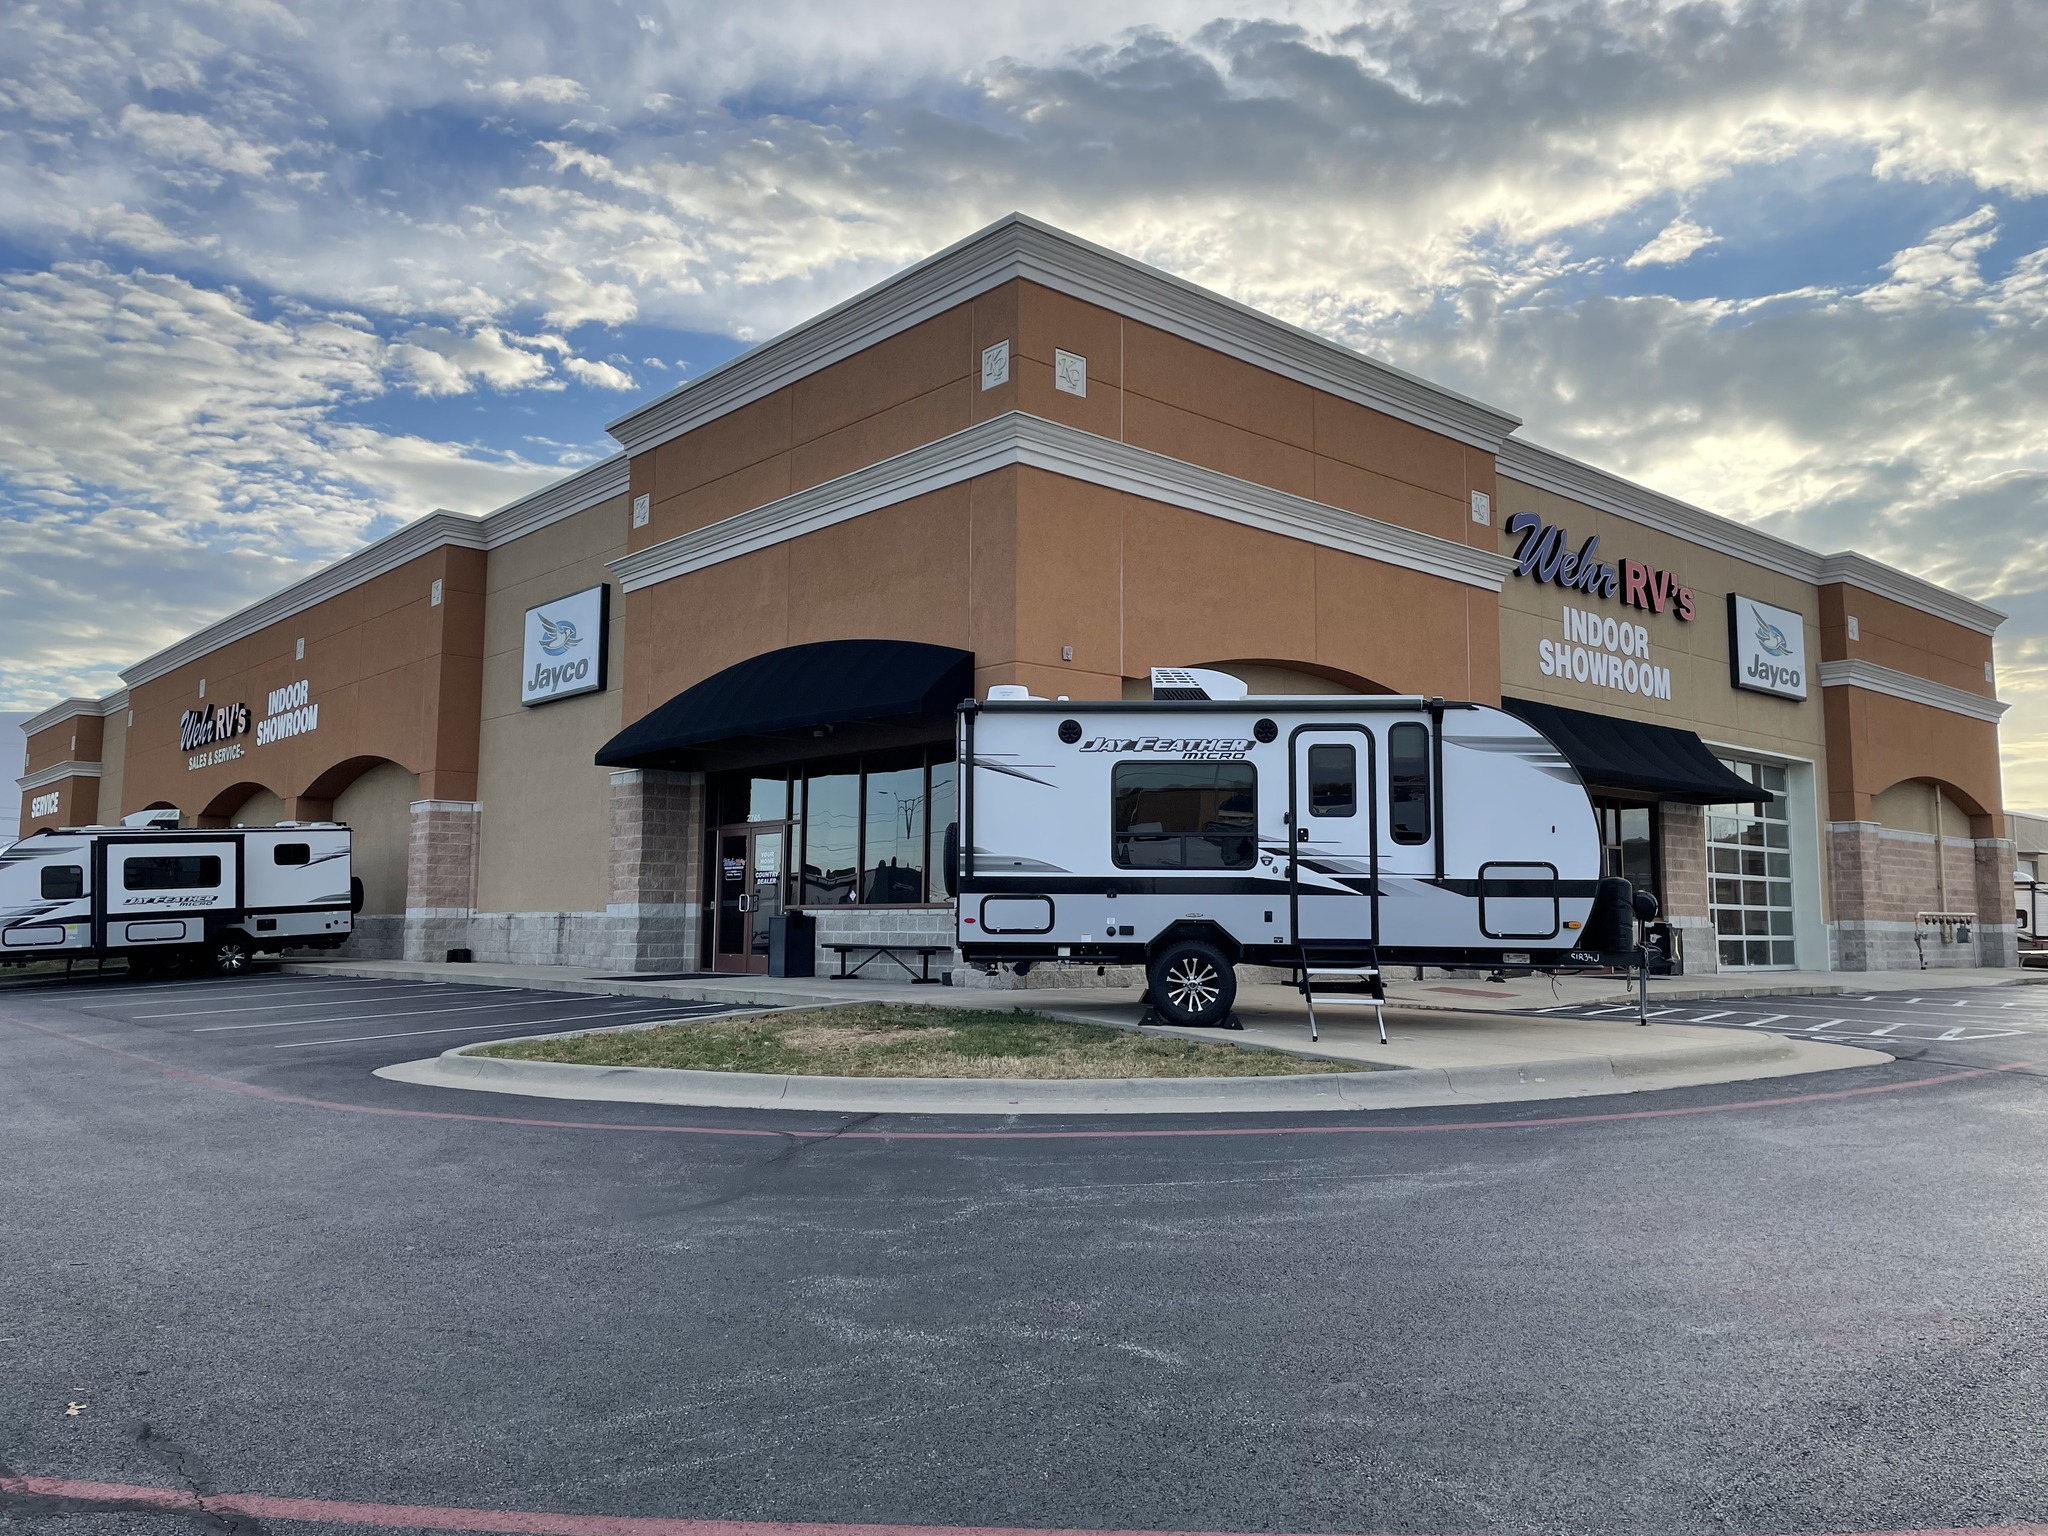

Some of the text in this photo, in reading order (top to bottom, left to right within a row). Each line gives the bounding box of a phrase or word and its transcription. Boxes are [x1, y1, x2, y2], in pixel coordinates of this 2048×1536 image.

[1506, 511, 1697, 622] Wehr RV's
[1562, 606, 1650, 660] INDOOR
[527, 658, 589, 693] Jayco
[1538, 639, 1672, 701] SHOWROOM
[1747, 653, 1801, 688] Jayco
[267, 679, 309, 717] INDOOR
[180, 702, 248, 752] Wehr RV's
[256, 703, 319, 747] SHOWROOM
[188, 743, 242, 771] SALES & SERVICE
[1078, 736, 1249, 753] JAY FEATHER
[1181, 752, 1246, 760] MICRO
[31, 791, 60, 819] SERVICE
[747, 814, 761, 823] 2765
